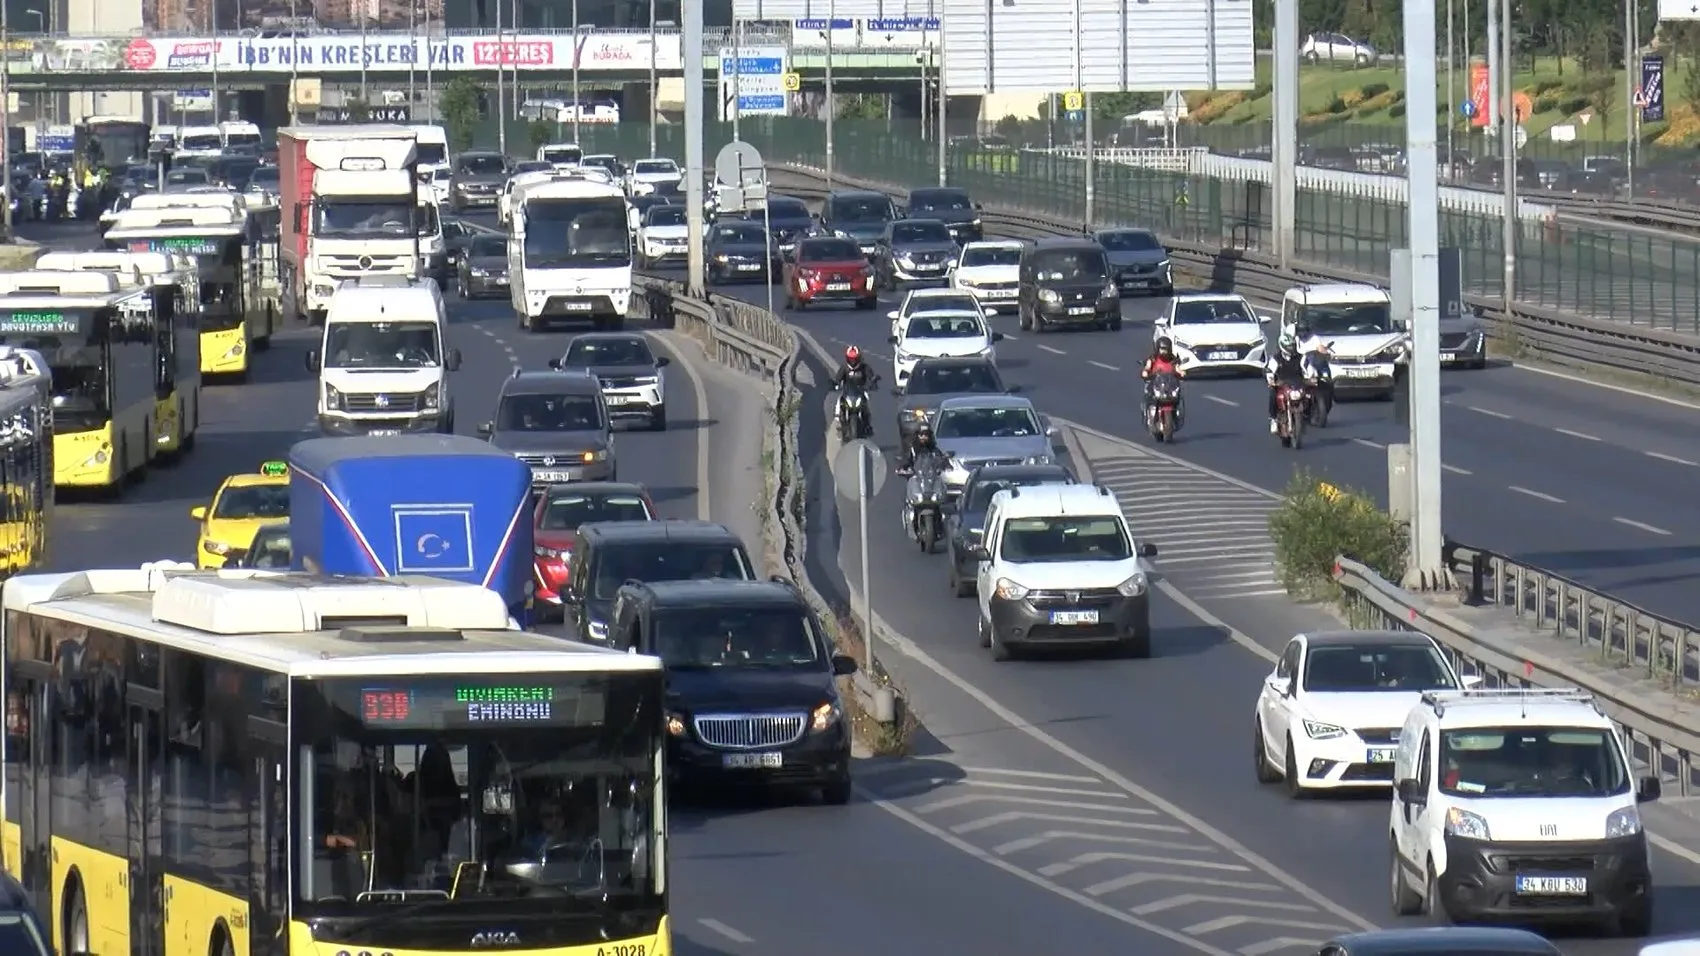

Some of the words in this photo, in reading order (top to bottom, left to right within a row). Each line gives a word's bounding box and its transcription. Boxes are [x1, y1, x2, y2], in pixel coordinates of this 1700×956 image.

[322, 40, 418, 69] KREŞLERİ
[427, 44, 464, 64] VAR
[1523, 877, 1536, 891] 34
